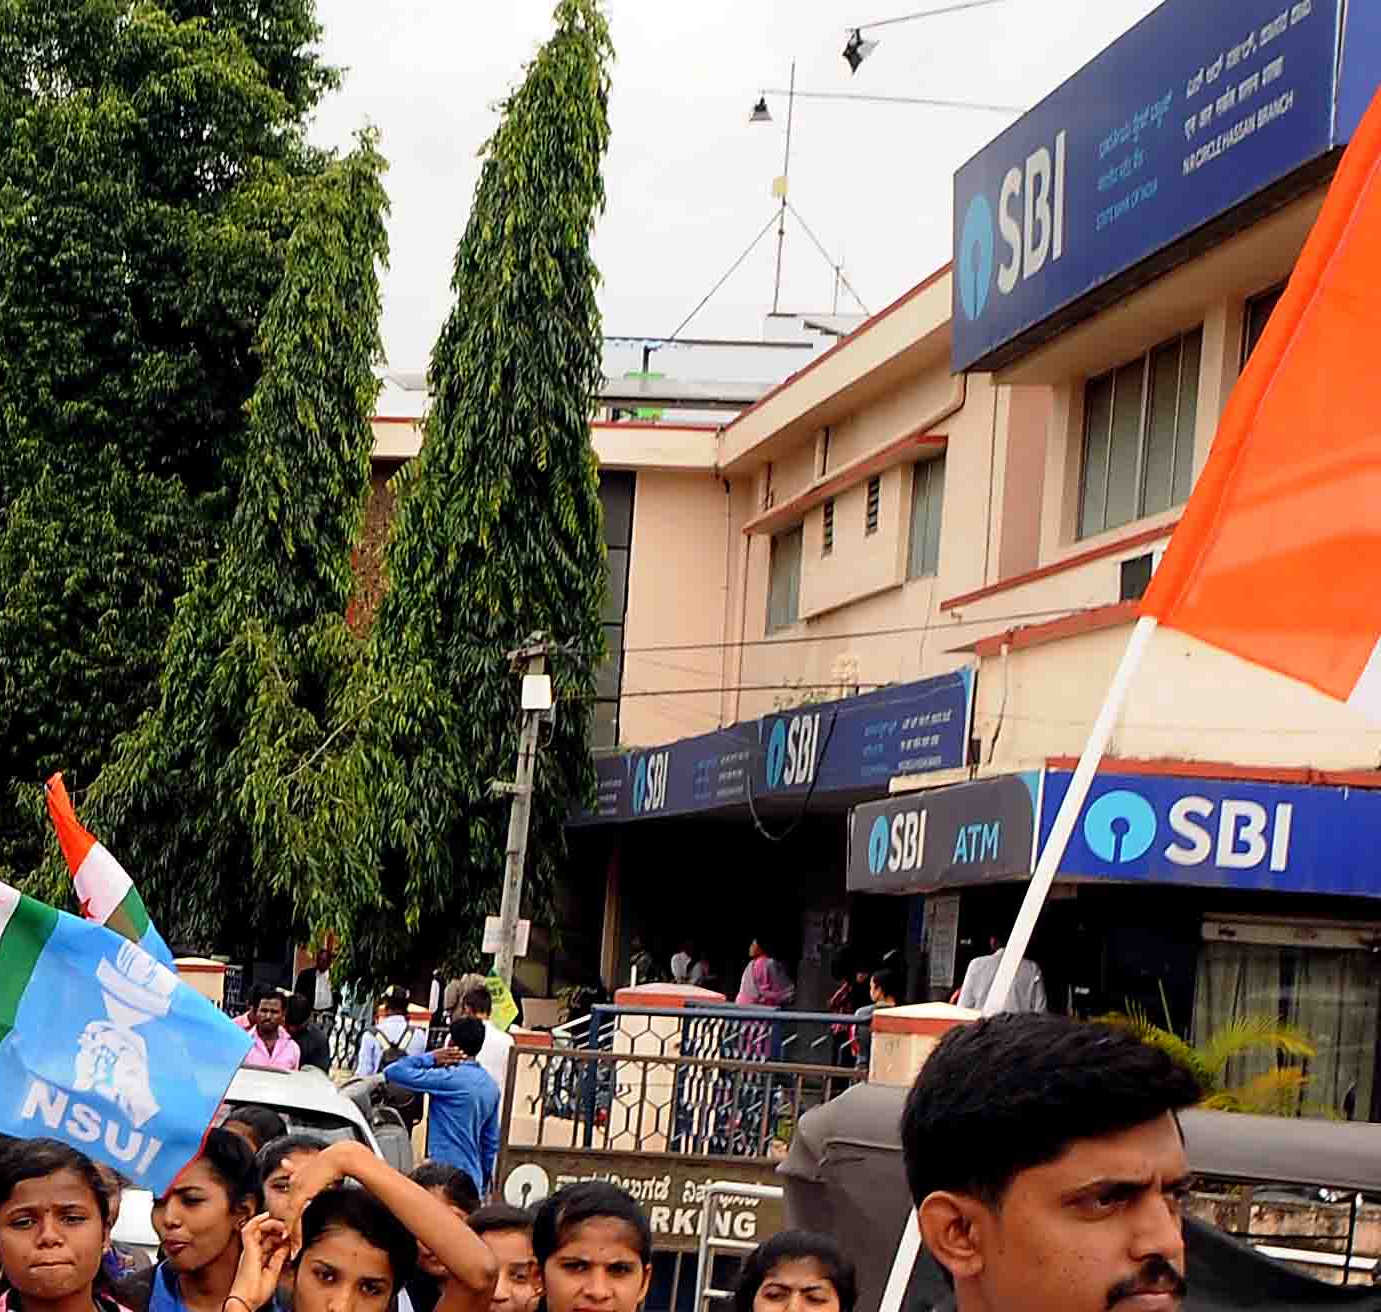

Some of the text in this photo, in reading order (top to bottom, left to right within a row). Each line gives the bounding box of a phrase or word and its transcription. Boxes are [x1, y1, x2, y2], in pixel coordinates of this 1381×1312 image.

[1257, 89, 1294, 129] BRANCH
[997, 129, 1066, 295] SBI
[644, 752, 669, 811] SBI
[783, 713, 821, 786] SBI
[888, 809, 1000, 873] SBI ATM
[1164, 796, 1293, 872] SBI
[21, 1079, 163, 1176] NSUI
[650, 1206, 757, 1239] RKING
